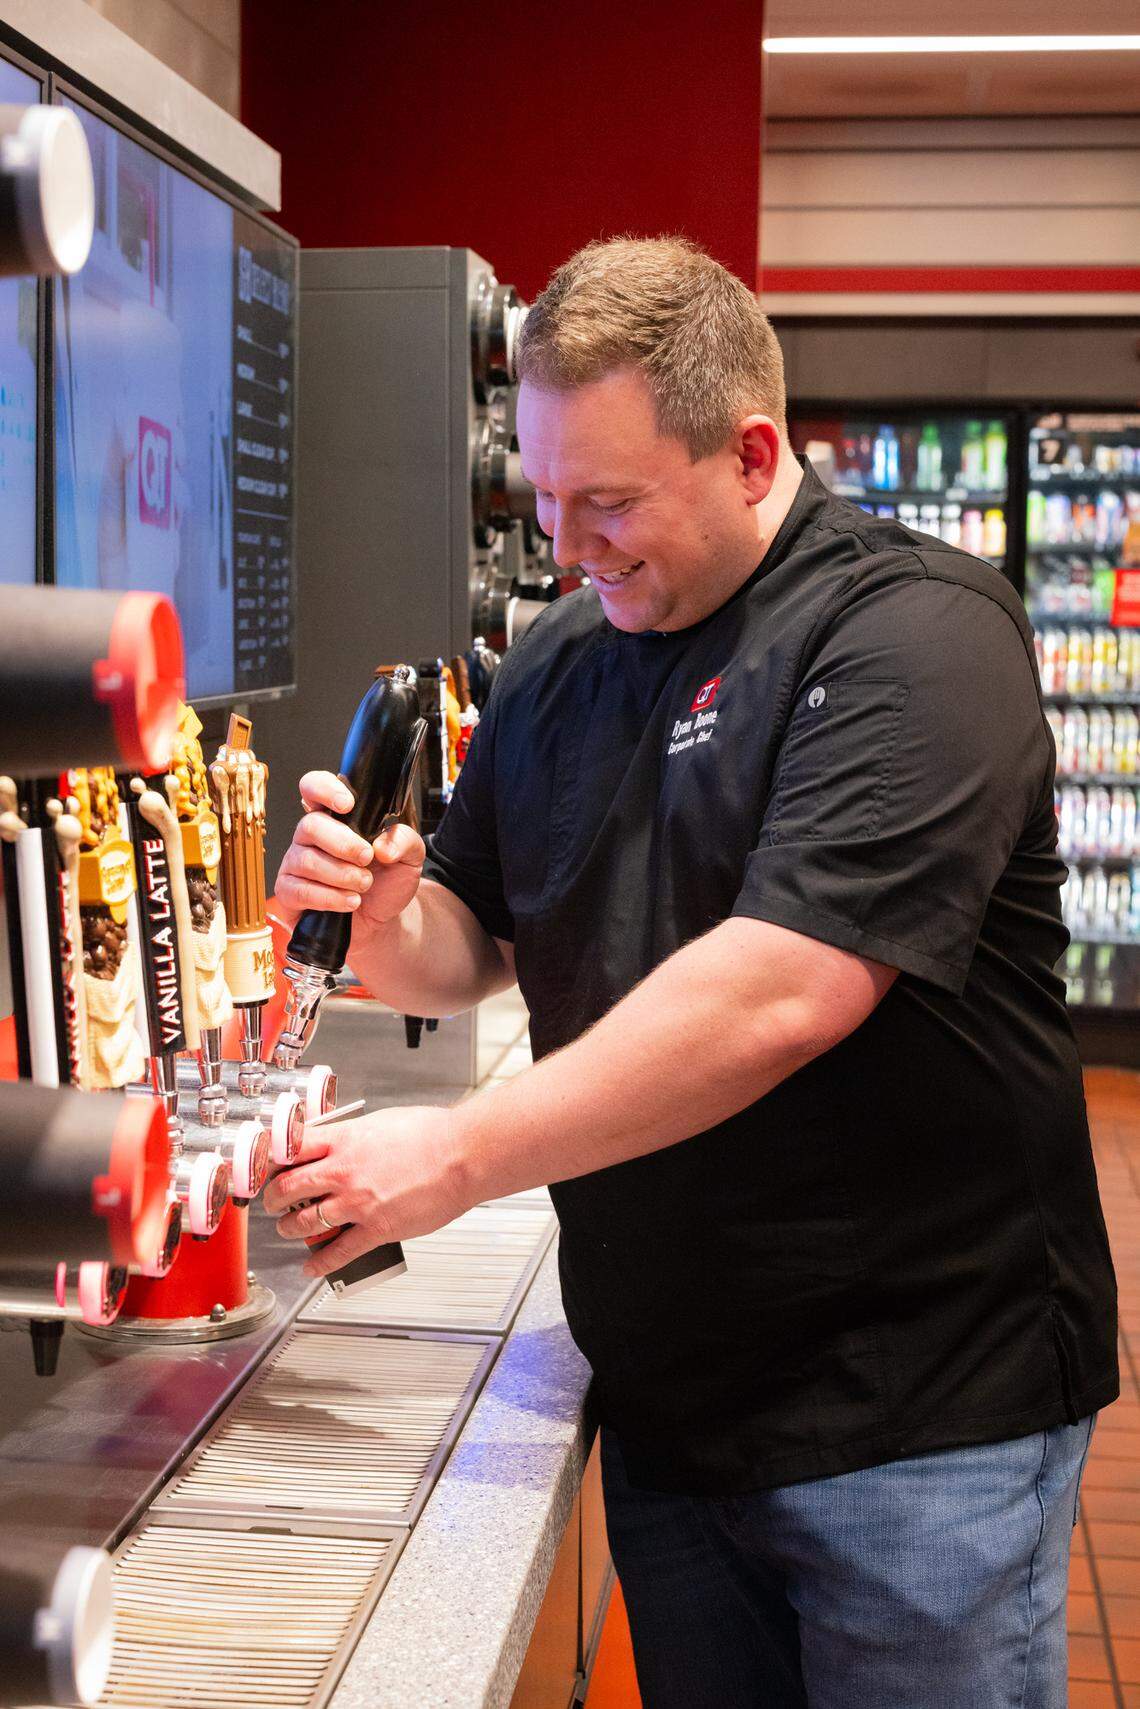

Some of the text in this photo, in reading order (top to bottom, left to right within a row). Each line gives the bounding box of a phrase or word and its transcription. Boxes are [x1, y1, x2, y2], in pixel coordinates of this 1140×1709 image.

[141, 430, 168, 513] QT
[697, 682, 716, 704] QT
[672, 711, 717, 740] Ryan Boone
[145, 838, 182, 1045] VANILLA LATTE
